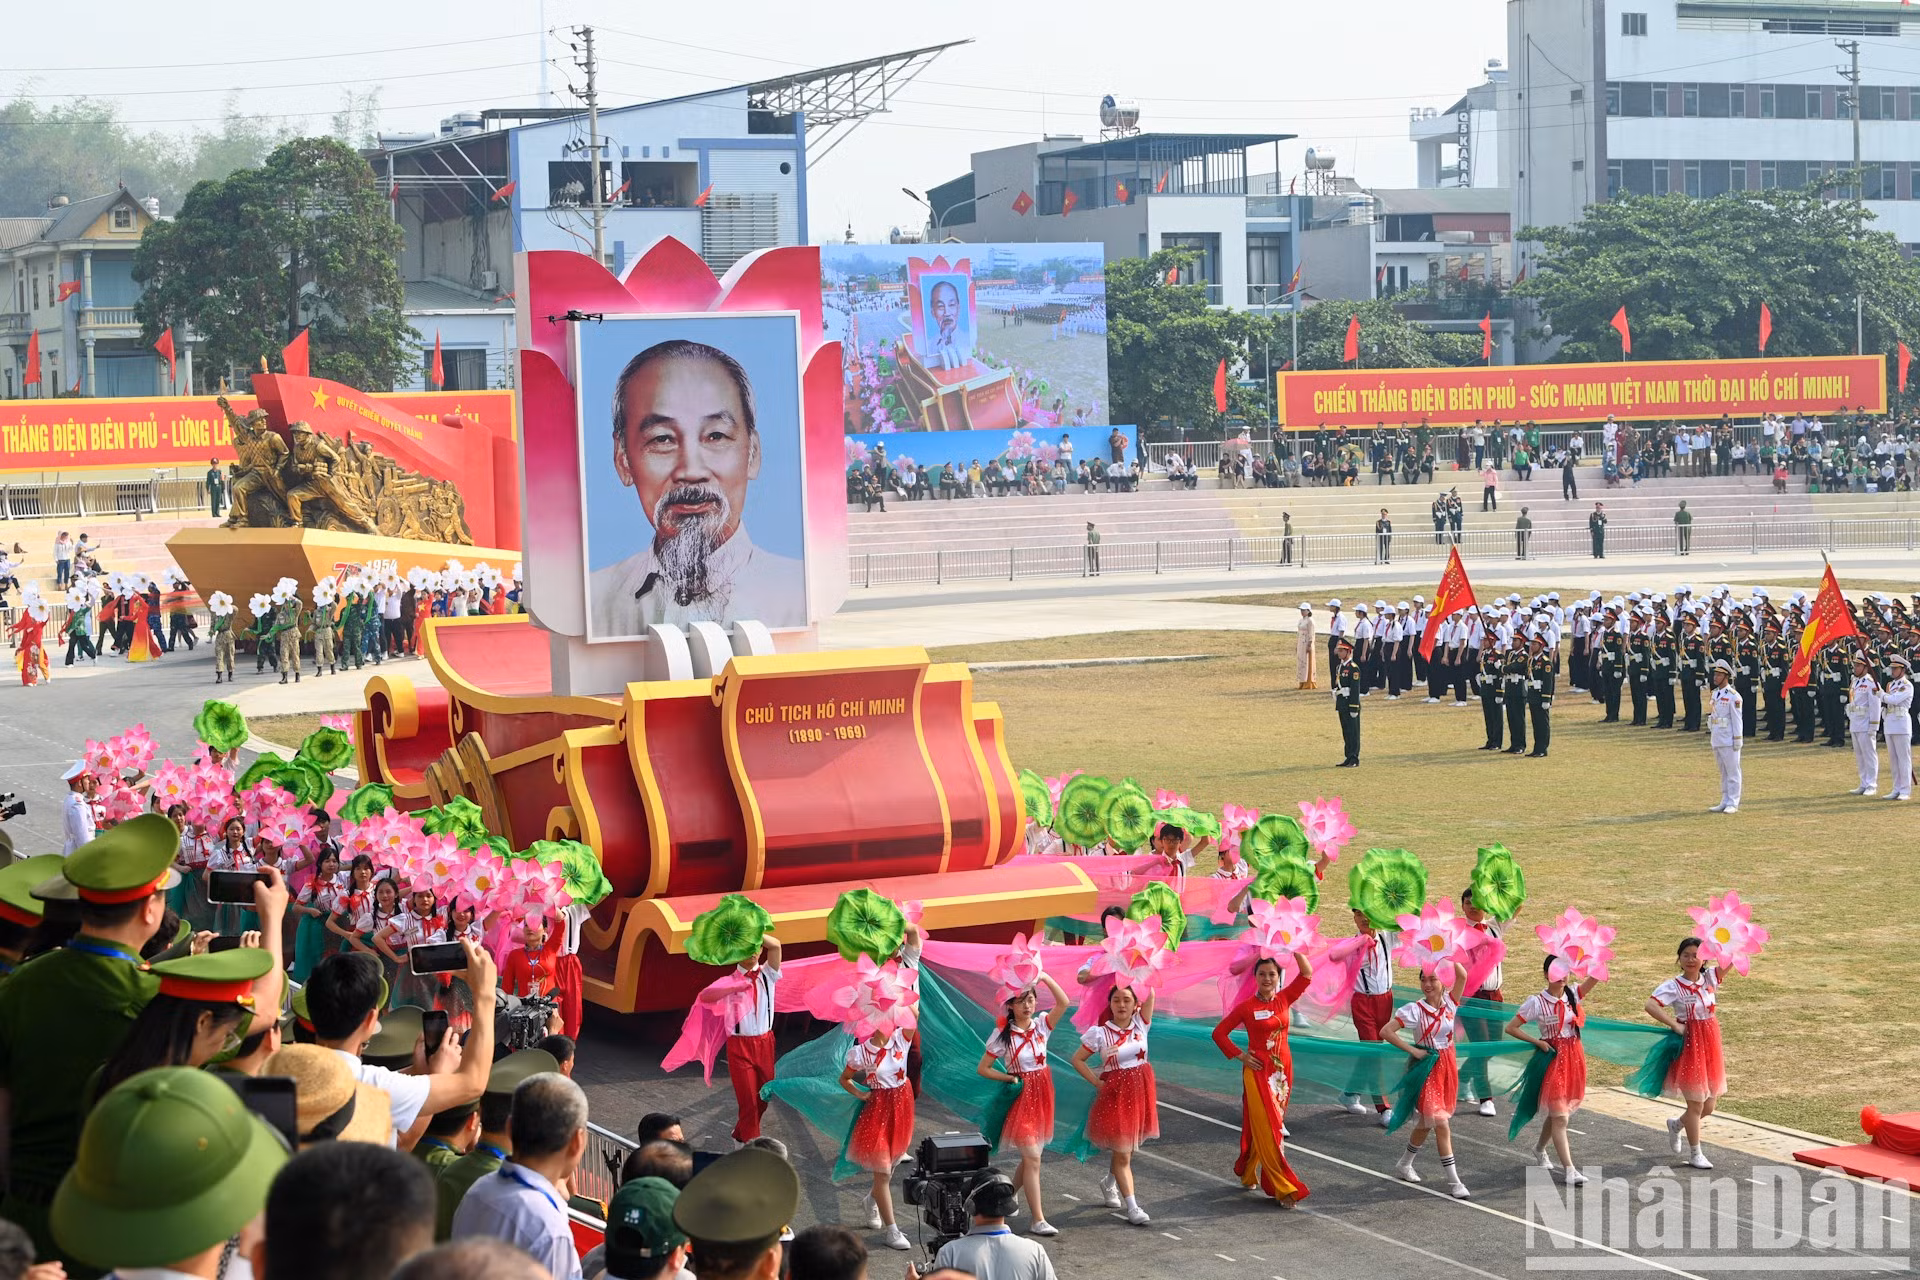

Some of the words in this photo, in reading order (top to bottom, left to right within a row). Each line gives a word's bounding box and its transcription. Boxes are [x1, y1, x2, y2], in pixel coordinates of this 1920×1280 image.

[1313, 383, 1357, 414] CHIẾN
[1360, 380, 1408, 413] THẮNG
[1411, 383, 1446, 417] ĐIỆN
[1449, 383, 1483, 411] BIÊN
[1487, 378, 1516, 409] PHỦ
[1529, 379, 1559, 408] SỨC
[1563, 383, 1607, 412] MẠNH
[1610, 376, 1642, 410] VIỆT
[1645, 380, 1680, 404] NAM
[1683, 373, 1717, 403] THỜI
[1719, 378, 1745, 407] ĐẠI
[1749, 370, 1770, 401] HỒ
[1773, 372, 1799, 401] CHÍ
[2, 414, 49, 454] THẮNG
[52, 418, 88, 458] ĐIỆN
[90, 416, 125, 451] BIÊN
[128, 411, 159, 449] PHỦ
[171, 414, 211, 447] LỪNG
[745, 702, 774, 724] CHỦ
[780, 704, 811, 724] TỊCH
[816, 699, 835, 719] HỒ
[840, 698, 864, 718] CHÍ
[868, 698, 905, 716] MINH
[789, 728, 822, 744] (1890
[833, 724, 867, 740] 1969)
